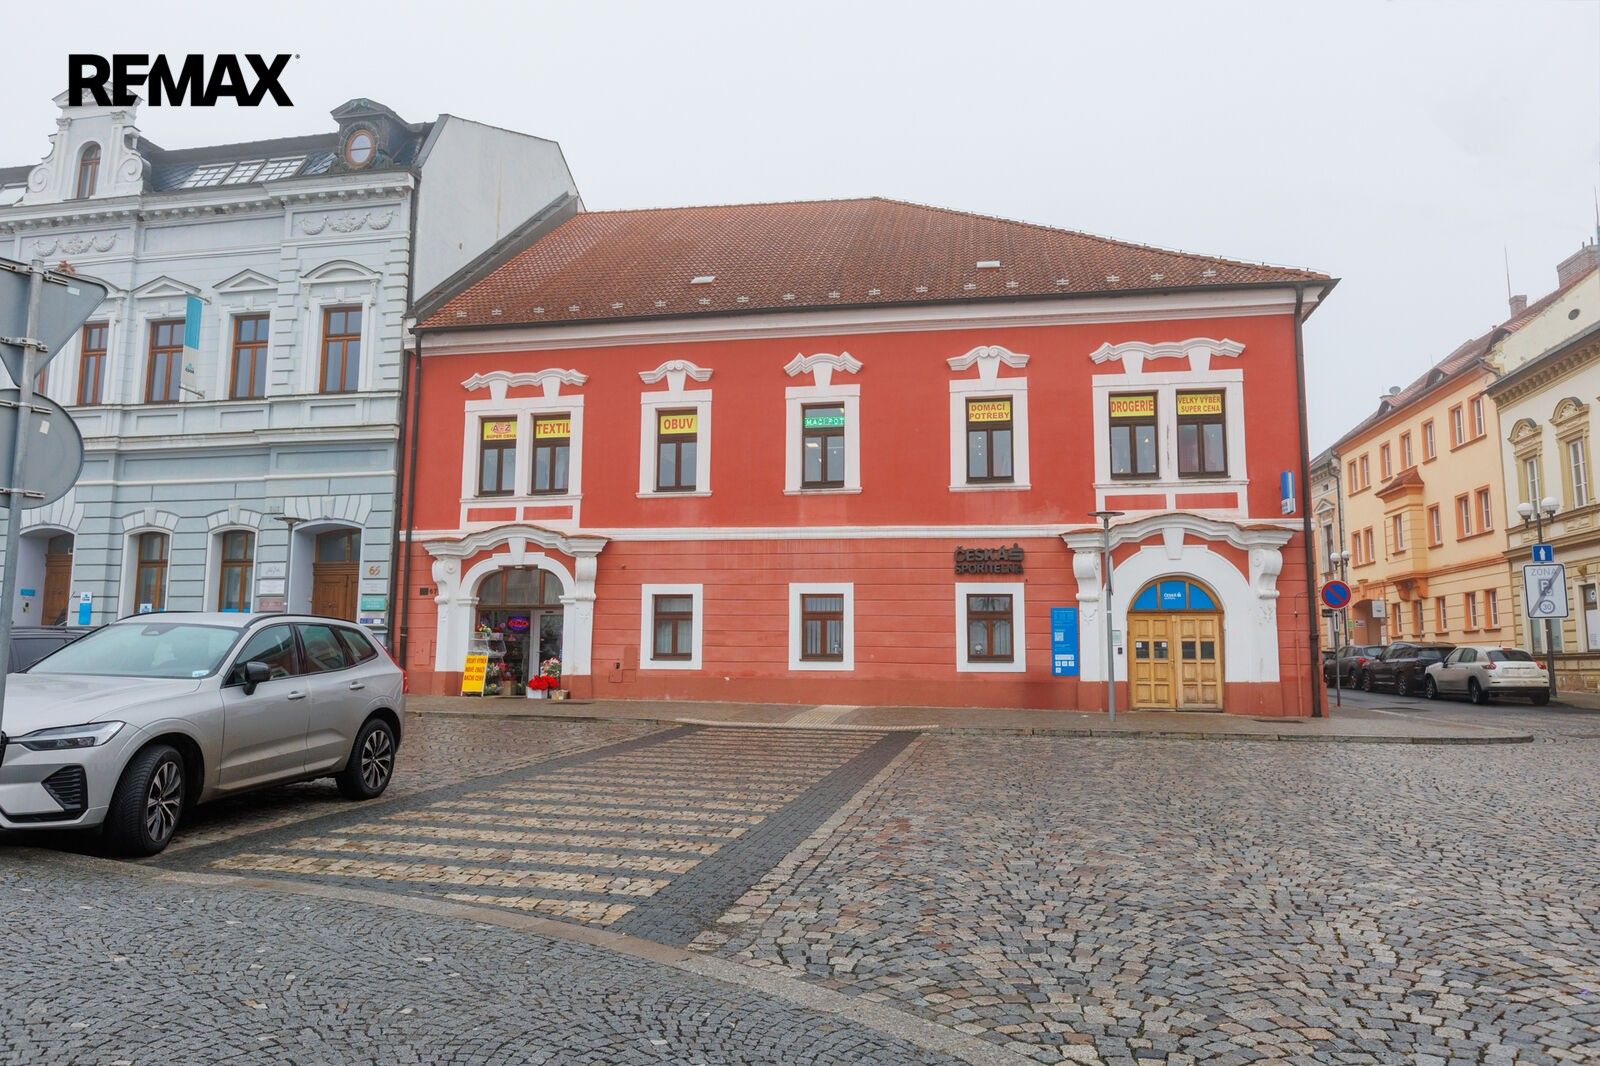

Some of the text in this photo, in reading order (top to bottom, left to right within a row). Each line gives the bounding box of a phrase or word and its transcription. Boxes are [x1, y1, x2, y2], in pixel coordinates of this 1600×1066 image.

[1111, 400, 1154, 412] DROGERIE
[1202, 404, 1220, 412] CENA
[536, 422, 571, 435] TEXTIL
[664, 418, 693, 430] OBUV
[955, 545, 1006, 561] ČESKÁ
[1542, 603, 1552, 611] 30
